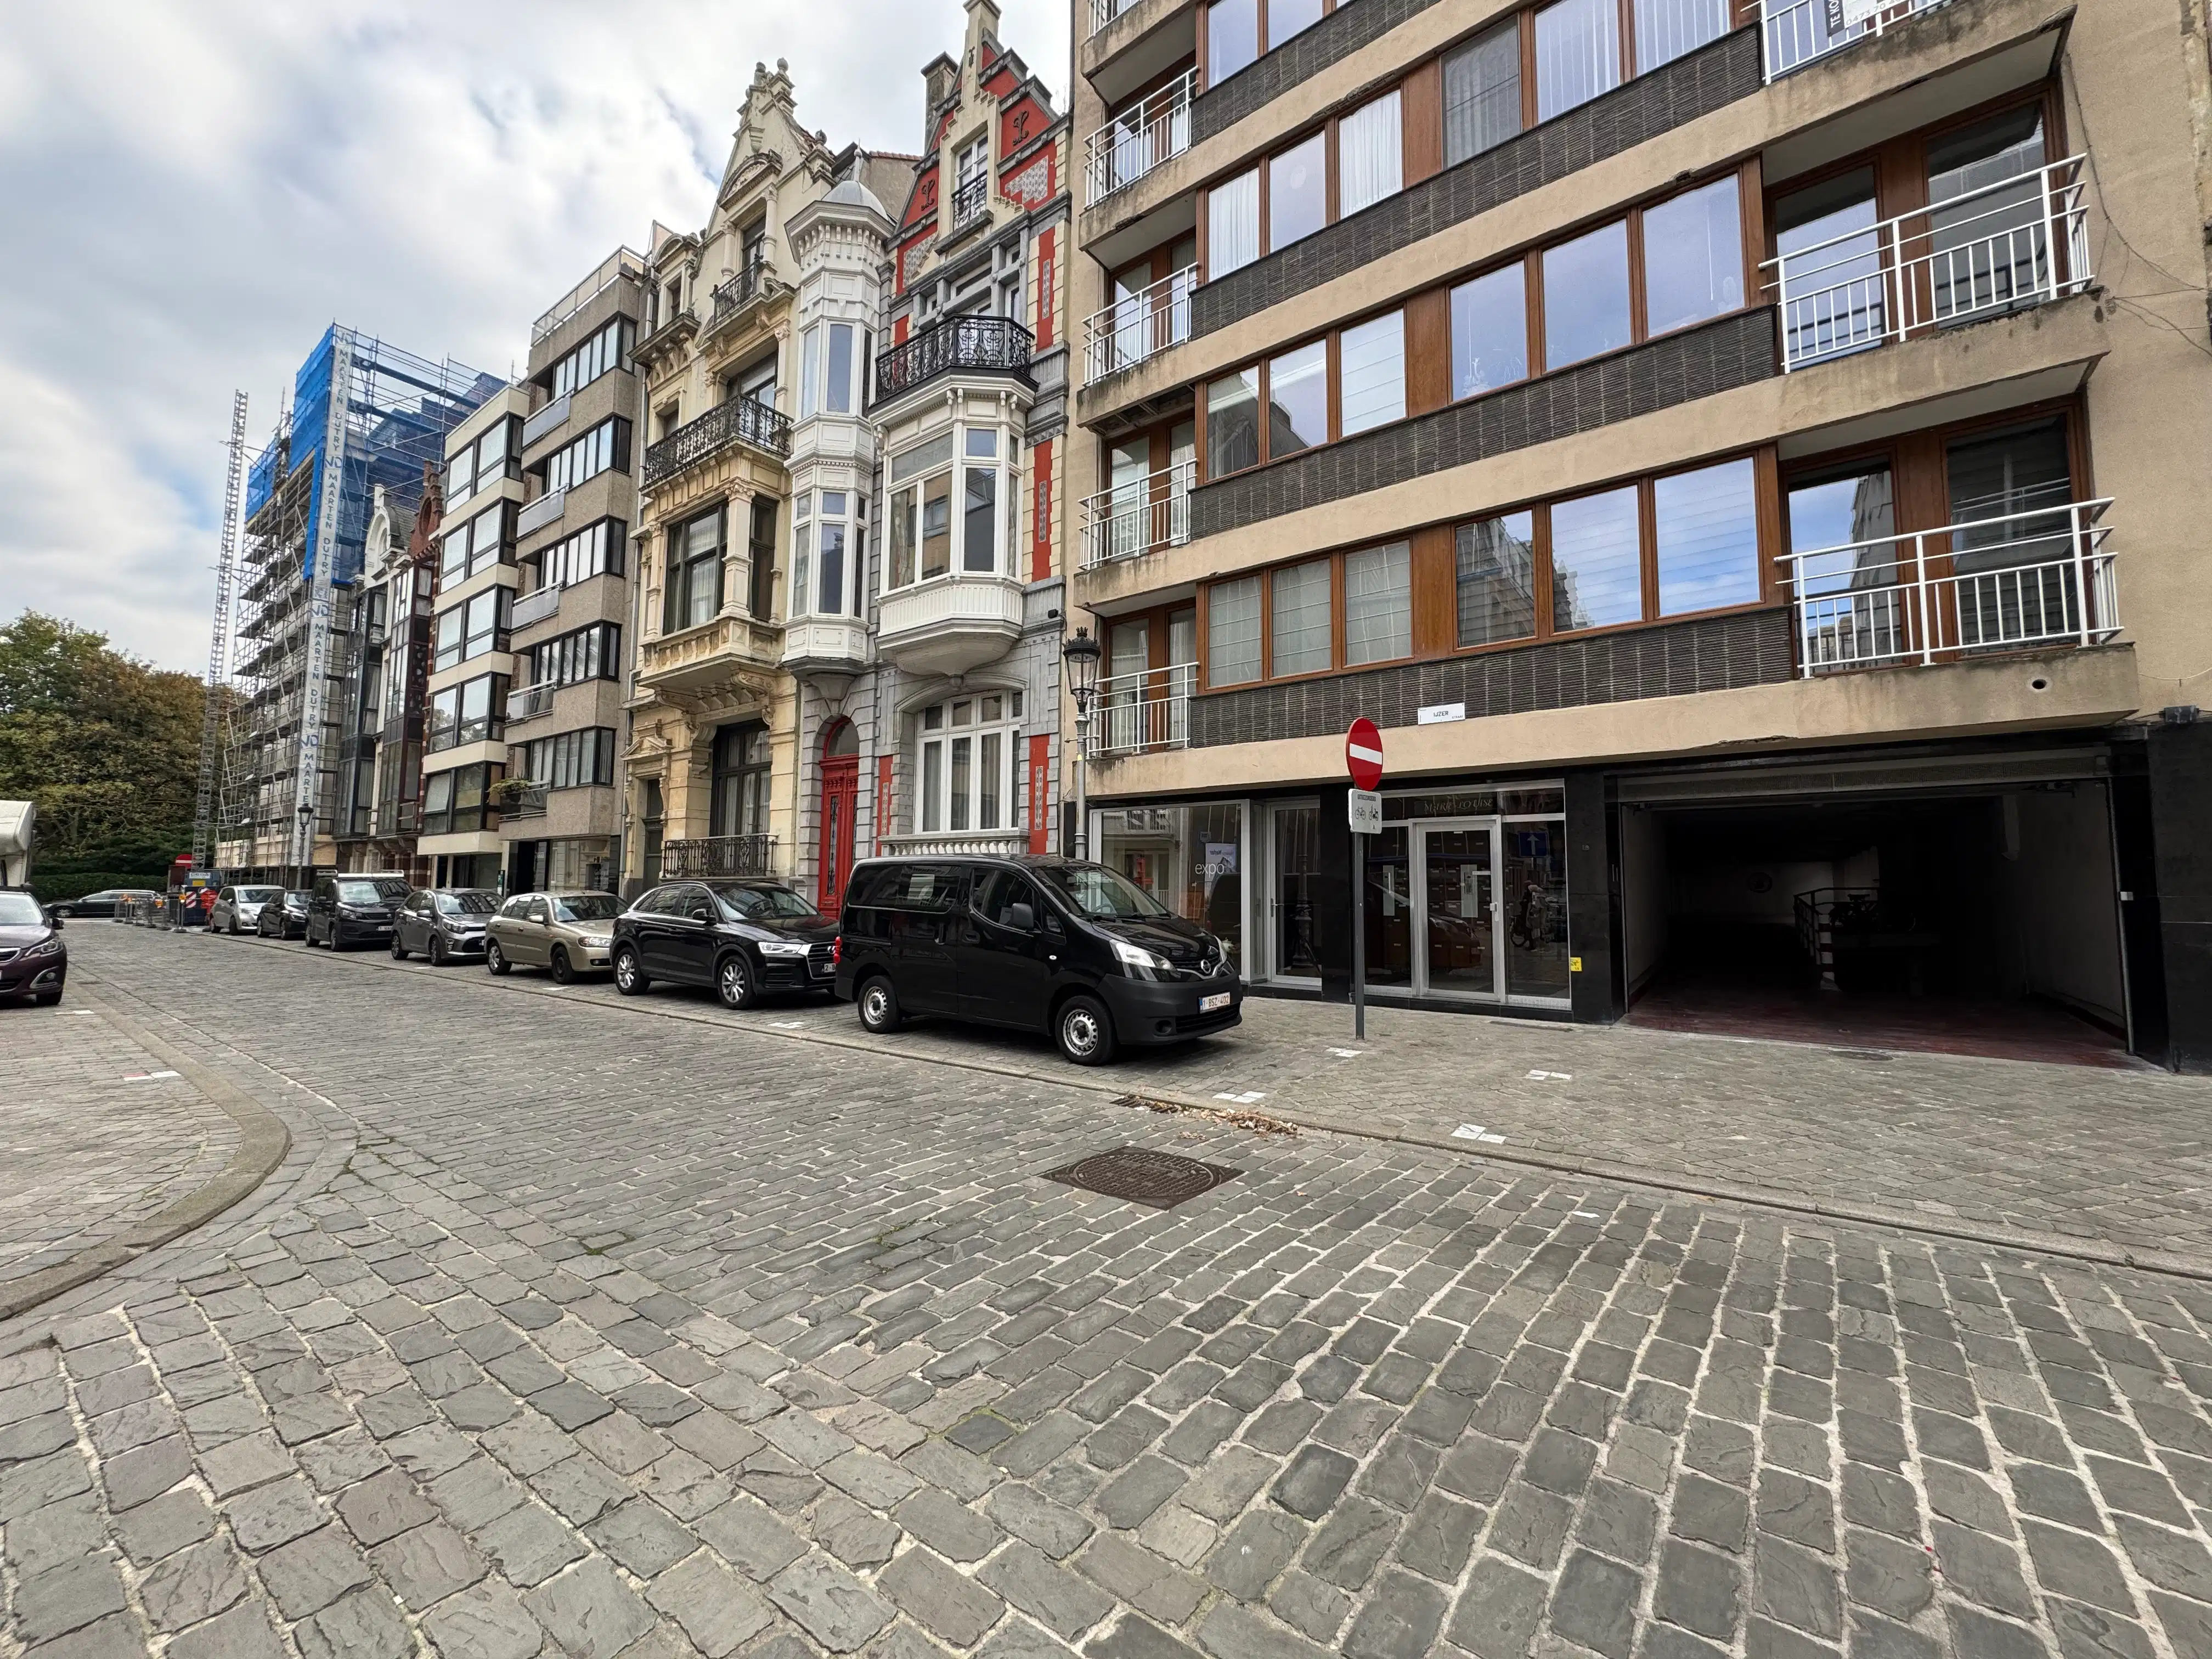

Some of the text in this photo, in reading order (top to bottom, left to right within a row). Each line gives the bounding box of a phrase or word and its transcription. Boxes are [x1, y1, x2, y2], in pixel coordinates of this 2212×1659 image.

[1829, 0, 1841, 28] TE KO
[333, 412, 342, 452] DUTRY
[320, 473, 338, 577] MAARTEN DUTRY
[309, 623, 324, 729] MAARTEN DUTRY
[303, 753, 314, 803] MAARTE
[1195, 864, 1224, 878] expo
